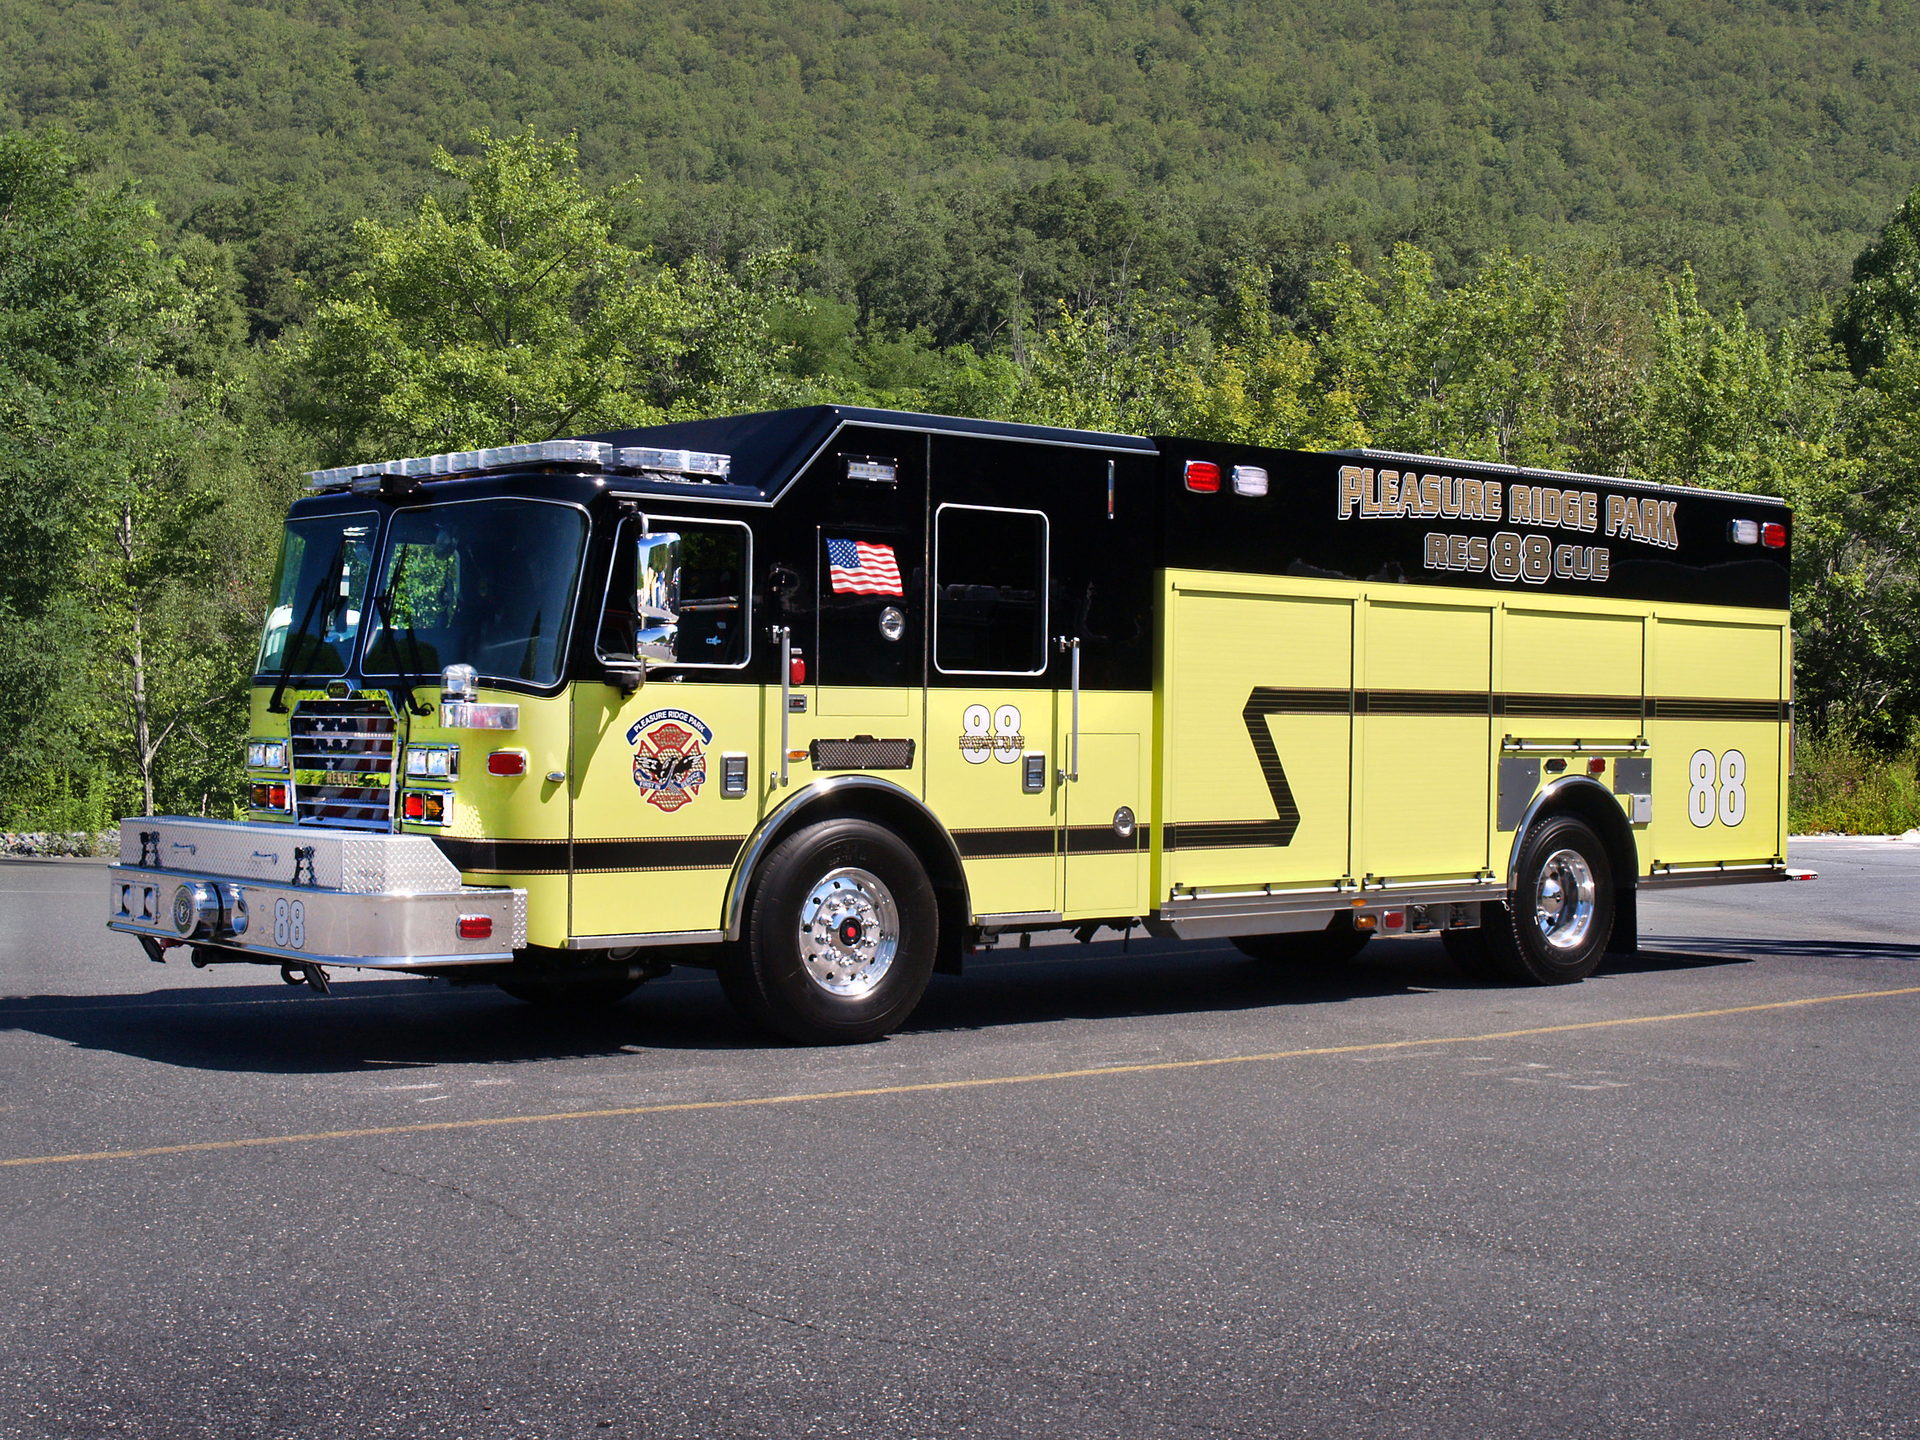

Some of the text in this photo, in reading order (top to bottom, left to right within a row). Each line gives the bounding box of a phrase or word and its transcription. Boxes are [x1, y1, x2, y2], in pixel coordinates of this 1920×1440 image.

[1338, 465, 1679, 550] PLEASURE RIDGE PARK
[1424, 531, 1610, 585] RES 88 CUE
[633, 710, 706, 733] PLEASURE RIDGE PARK
[660, 732, 681, 744] FIRE
[962, 704, 1022, 765] 88
[326, 772, 359, 785] RESCUE
[1687, 748, 1747, 829] 88
[273, 897, 306, 950] 88
